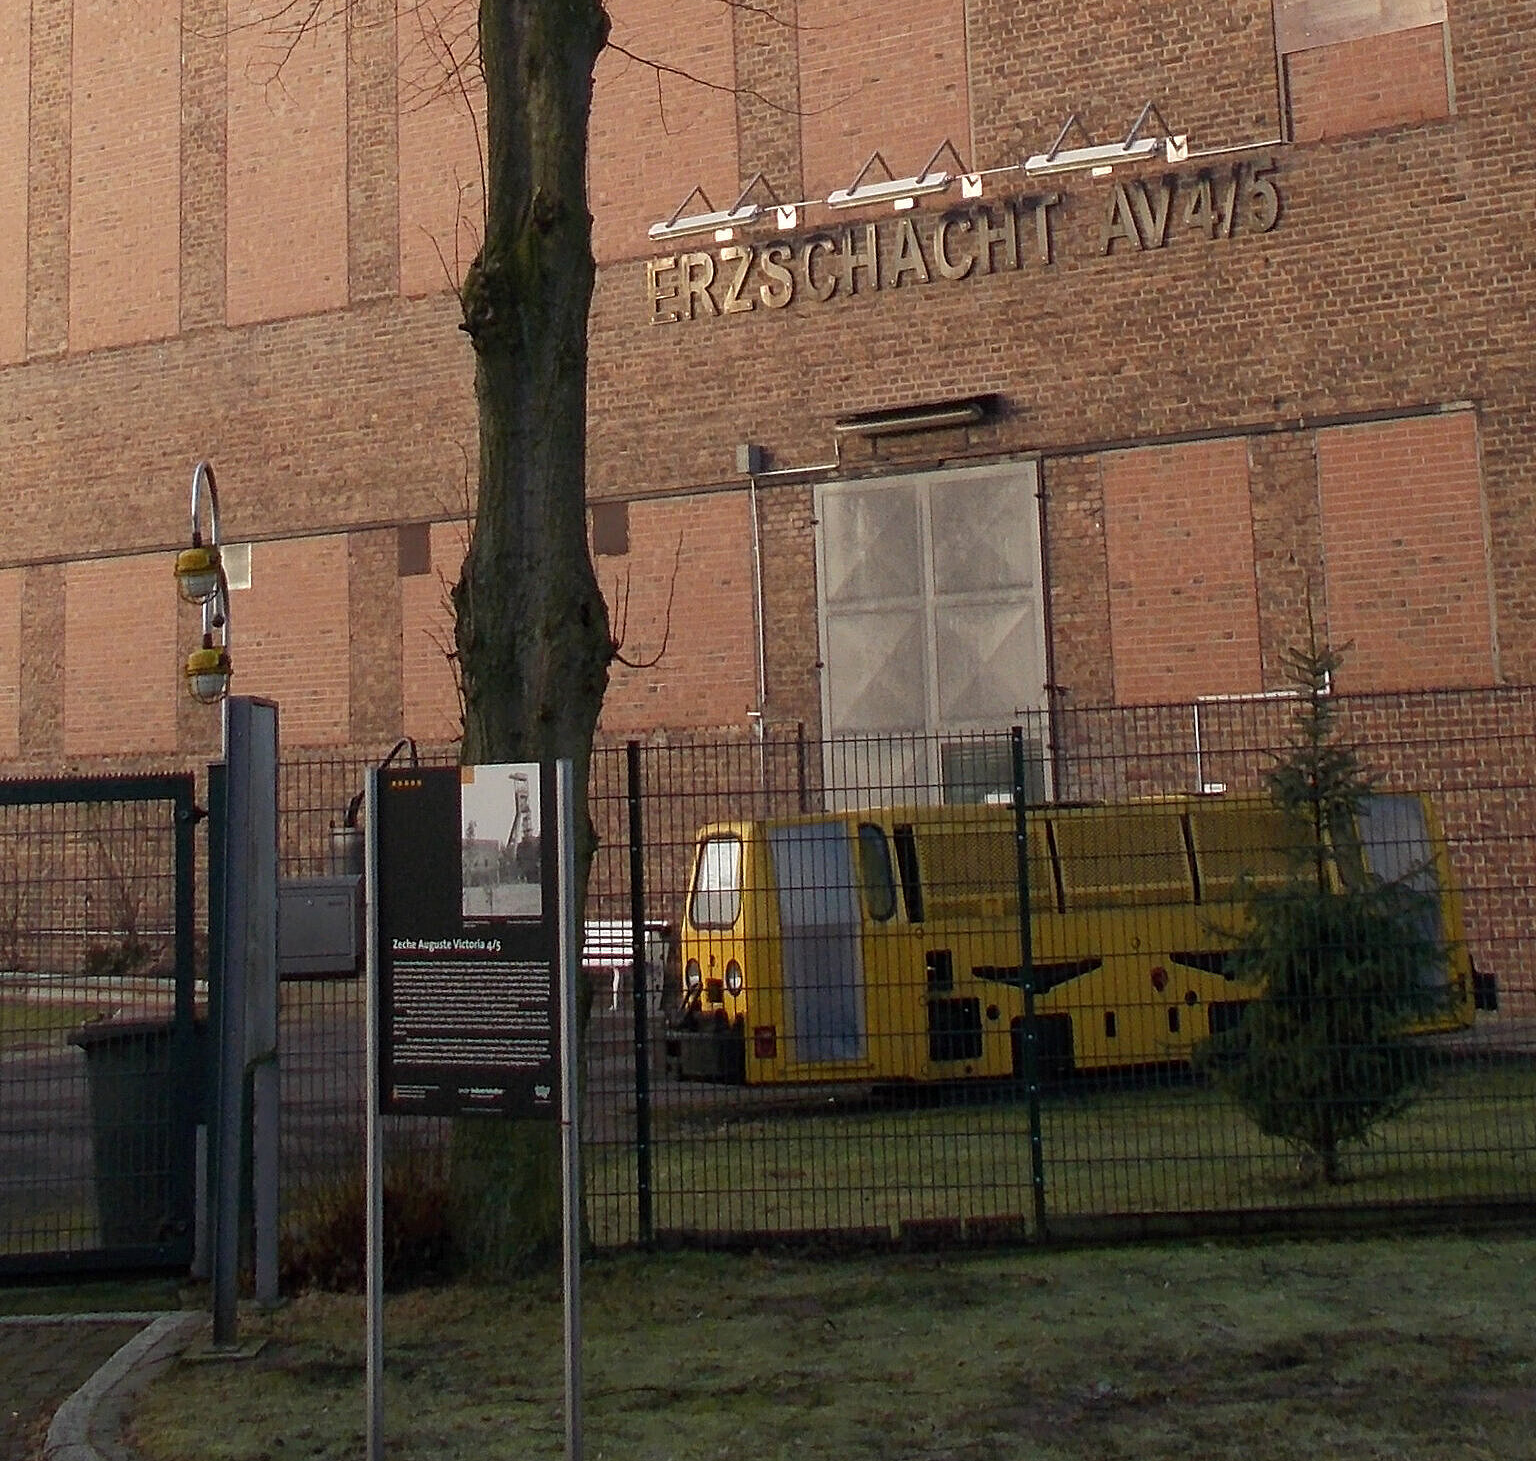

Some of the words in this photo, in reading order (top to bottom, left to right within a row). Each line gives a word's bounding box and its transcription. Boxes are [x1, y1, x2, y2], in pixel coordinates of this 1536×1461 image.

[649, 192, 1062, 326] ERZSCHACHT
[392, 939, 417, 950] Zeche
[418, 939, 452, 953] Auguste
[452, 938, 485, 950] Victoria
[486, 939, 502, 952] 4/5
